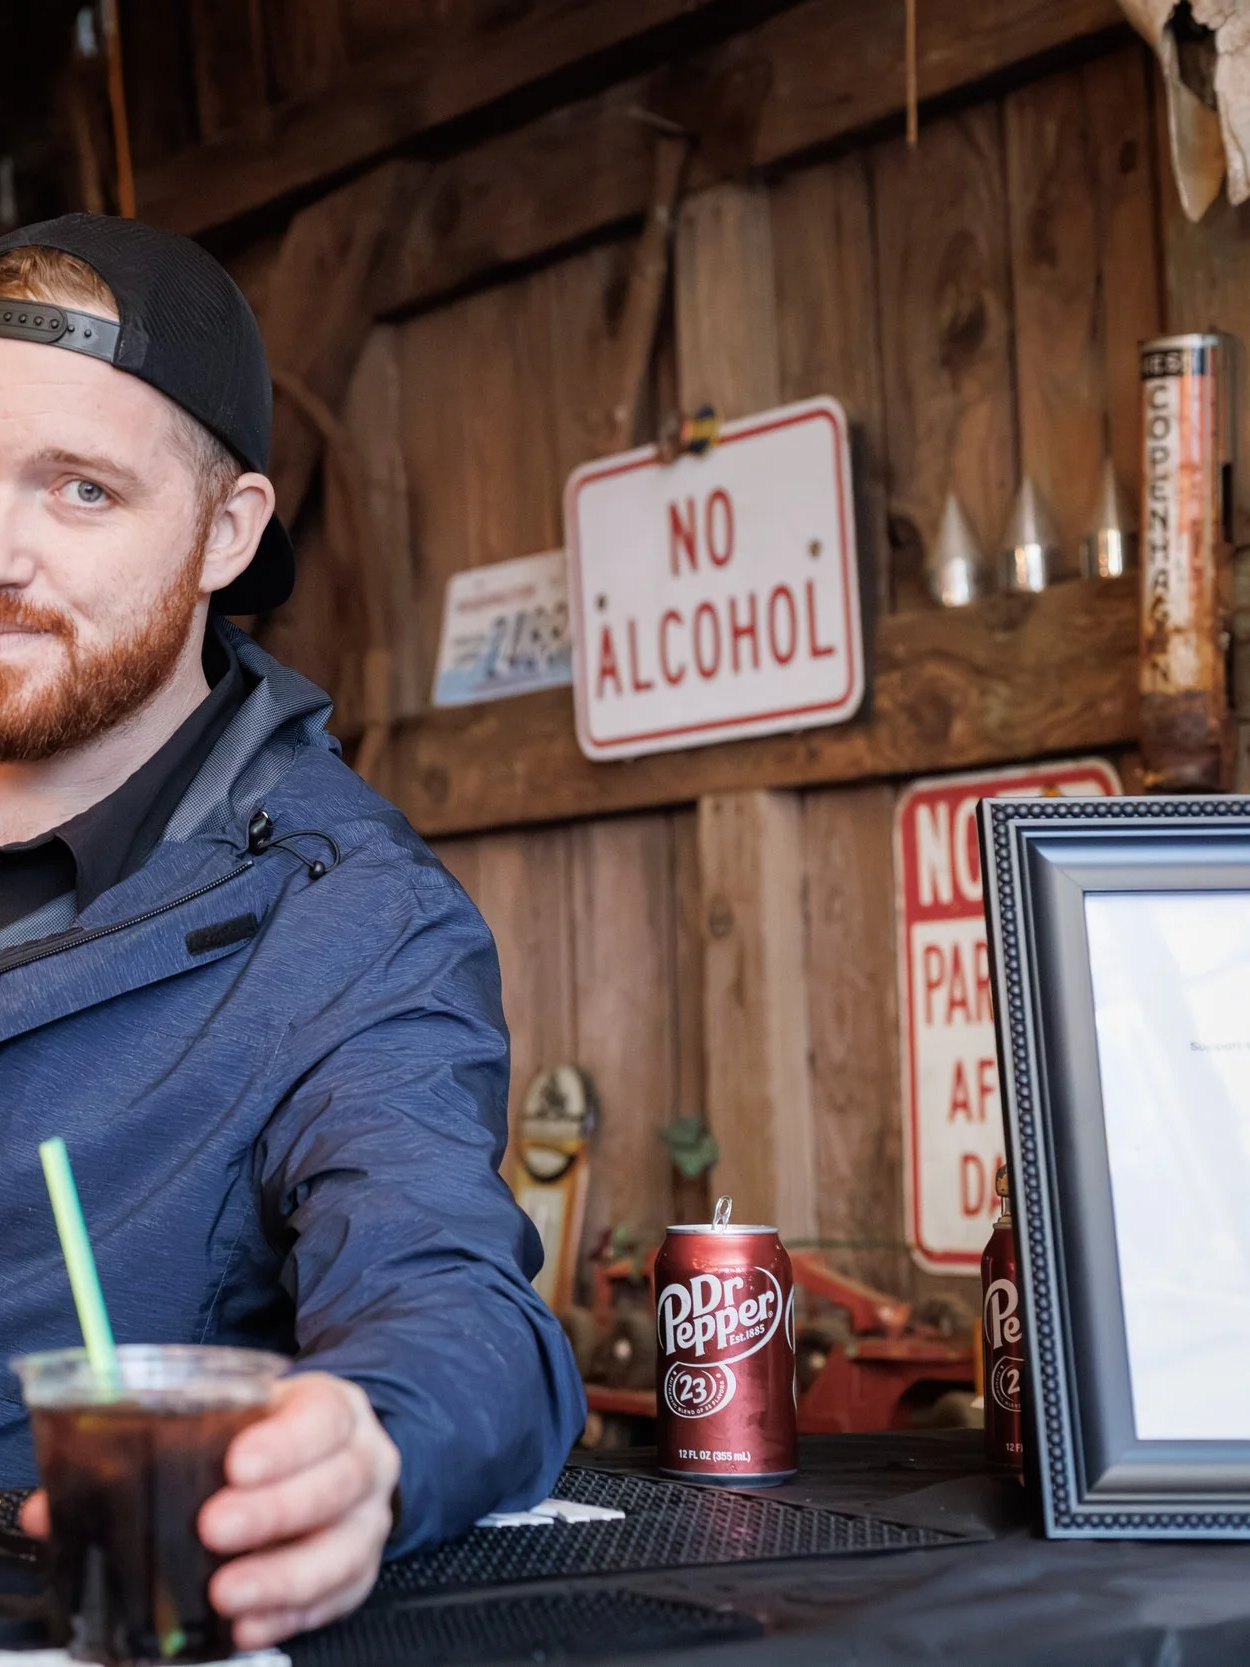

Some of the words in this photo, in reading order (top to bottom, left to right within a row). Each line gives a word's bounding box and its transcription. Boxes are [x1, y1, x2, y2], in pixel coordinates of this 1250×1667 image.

[669, 488, 735, 576] NO
[1150, 384, 1172, 683] COPENHAGN
[595, 579, 836, 700] ALCOHOL
[658, 1283, 775, 1357] Pepper
[690, 1274, 744, 1318] Dr
[680, 1375, 707, 1404] 23
[679, 1449, 688, 1459] 12
[689, 1450, 698, 1460] FL
[699, 1450, 711, 1460] OZ
[713, 1451, 732, 1462] (355
